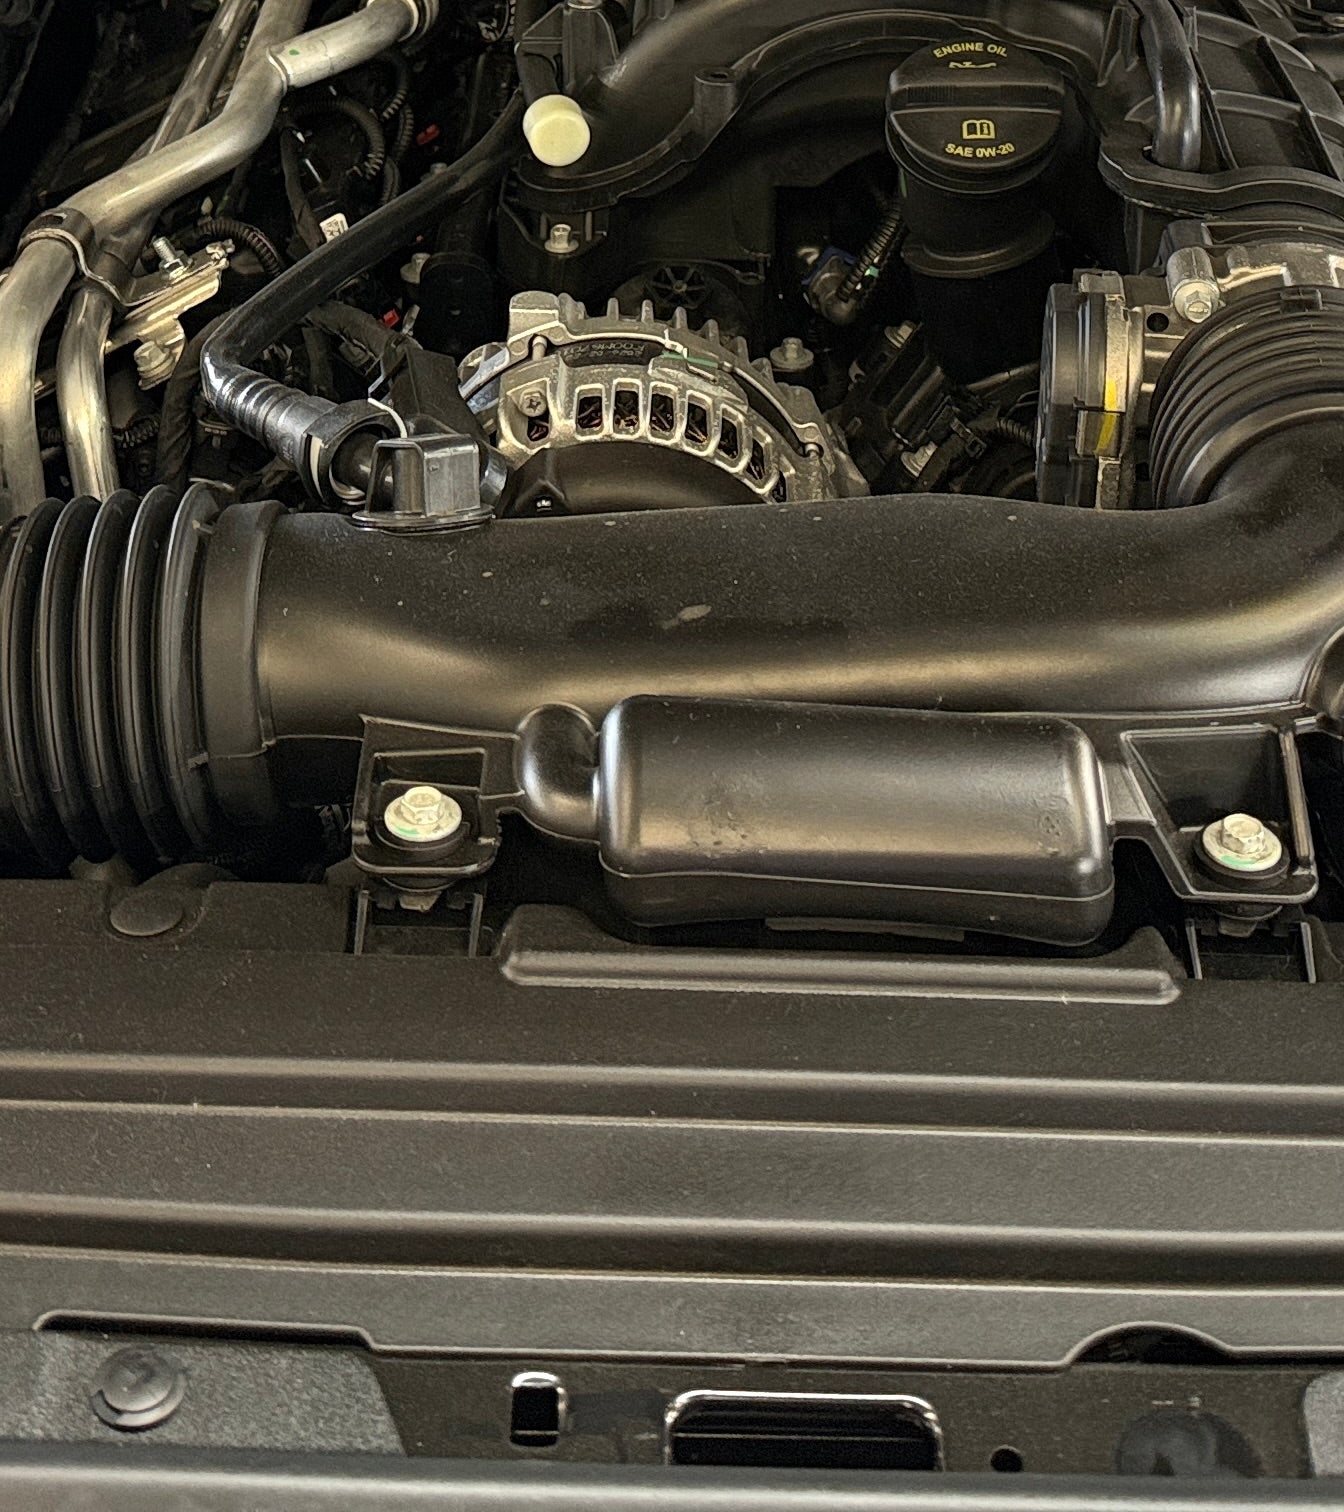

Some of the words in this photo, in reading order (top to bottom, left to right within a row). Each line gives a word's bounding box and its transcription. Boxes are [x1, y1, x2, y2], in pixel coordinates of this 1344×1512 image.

[932, 42, 984, 58] ENGINE
[987, 43, 1009, 58] OIL
[945, 142, 973, 158] SAE
[975, 142, 1015, 158] 0W-20
